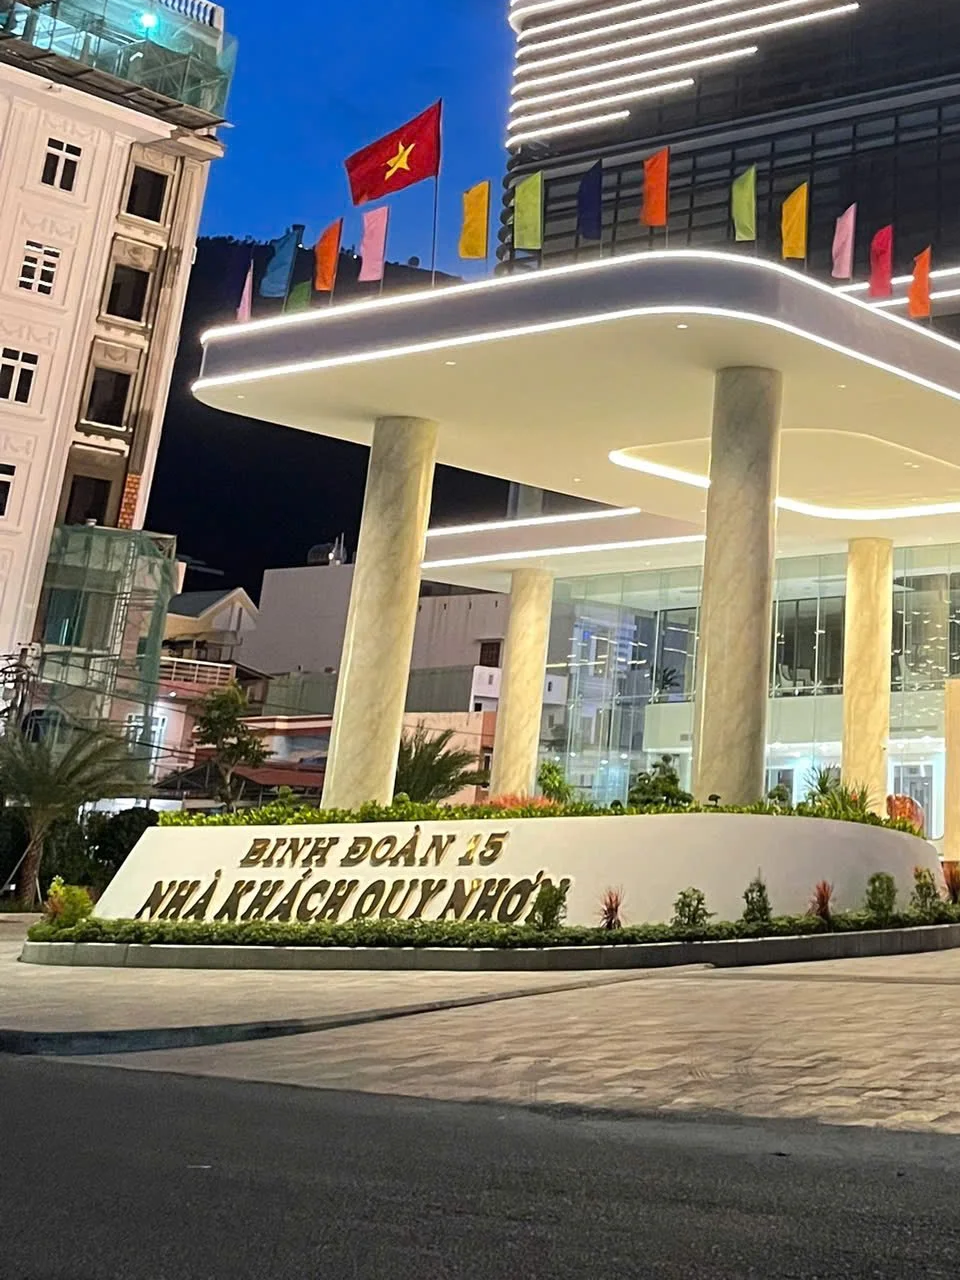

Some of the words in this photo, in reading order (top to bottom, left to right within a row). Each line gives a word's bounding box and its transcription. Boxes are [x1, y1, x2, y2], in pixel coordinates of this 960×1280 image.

[239, 837, 340, 868] BINH
[340, 825, 456, 867] ĐOÀN
[458, 831, 510, 867] 15
[134, 869, 222, 920] NHÀ
[213, 868, 360, 922] KHÁCH
